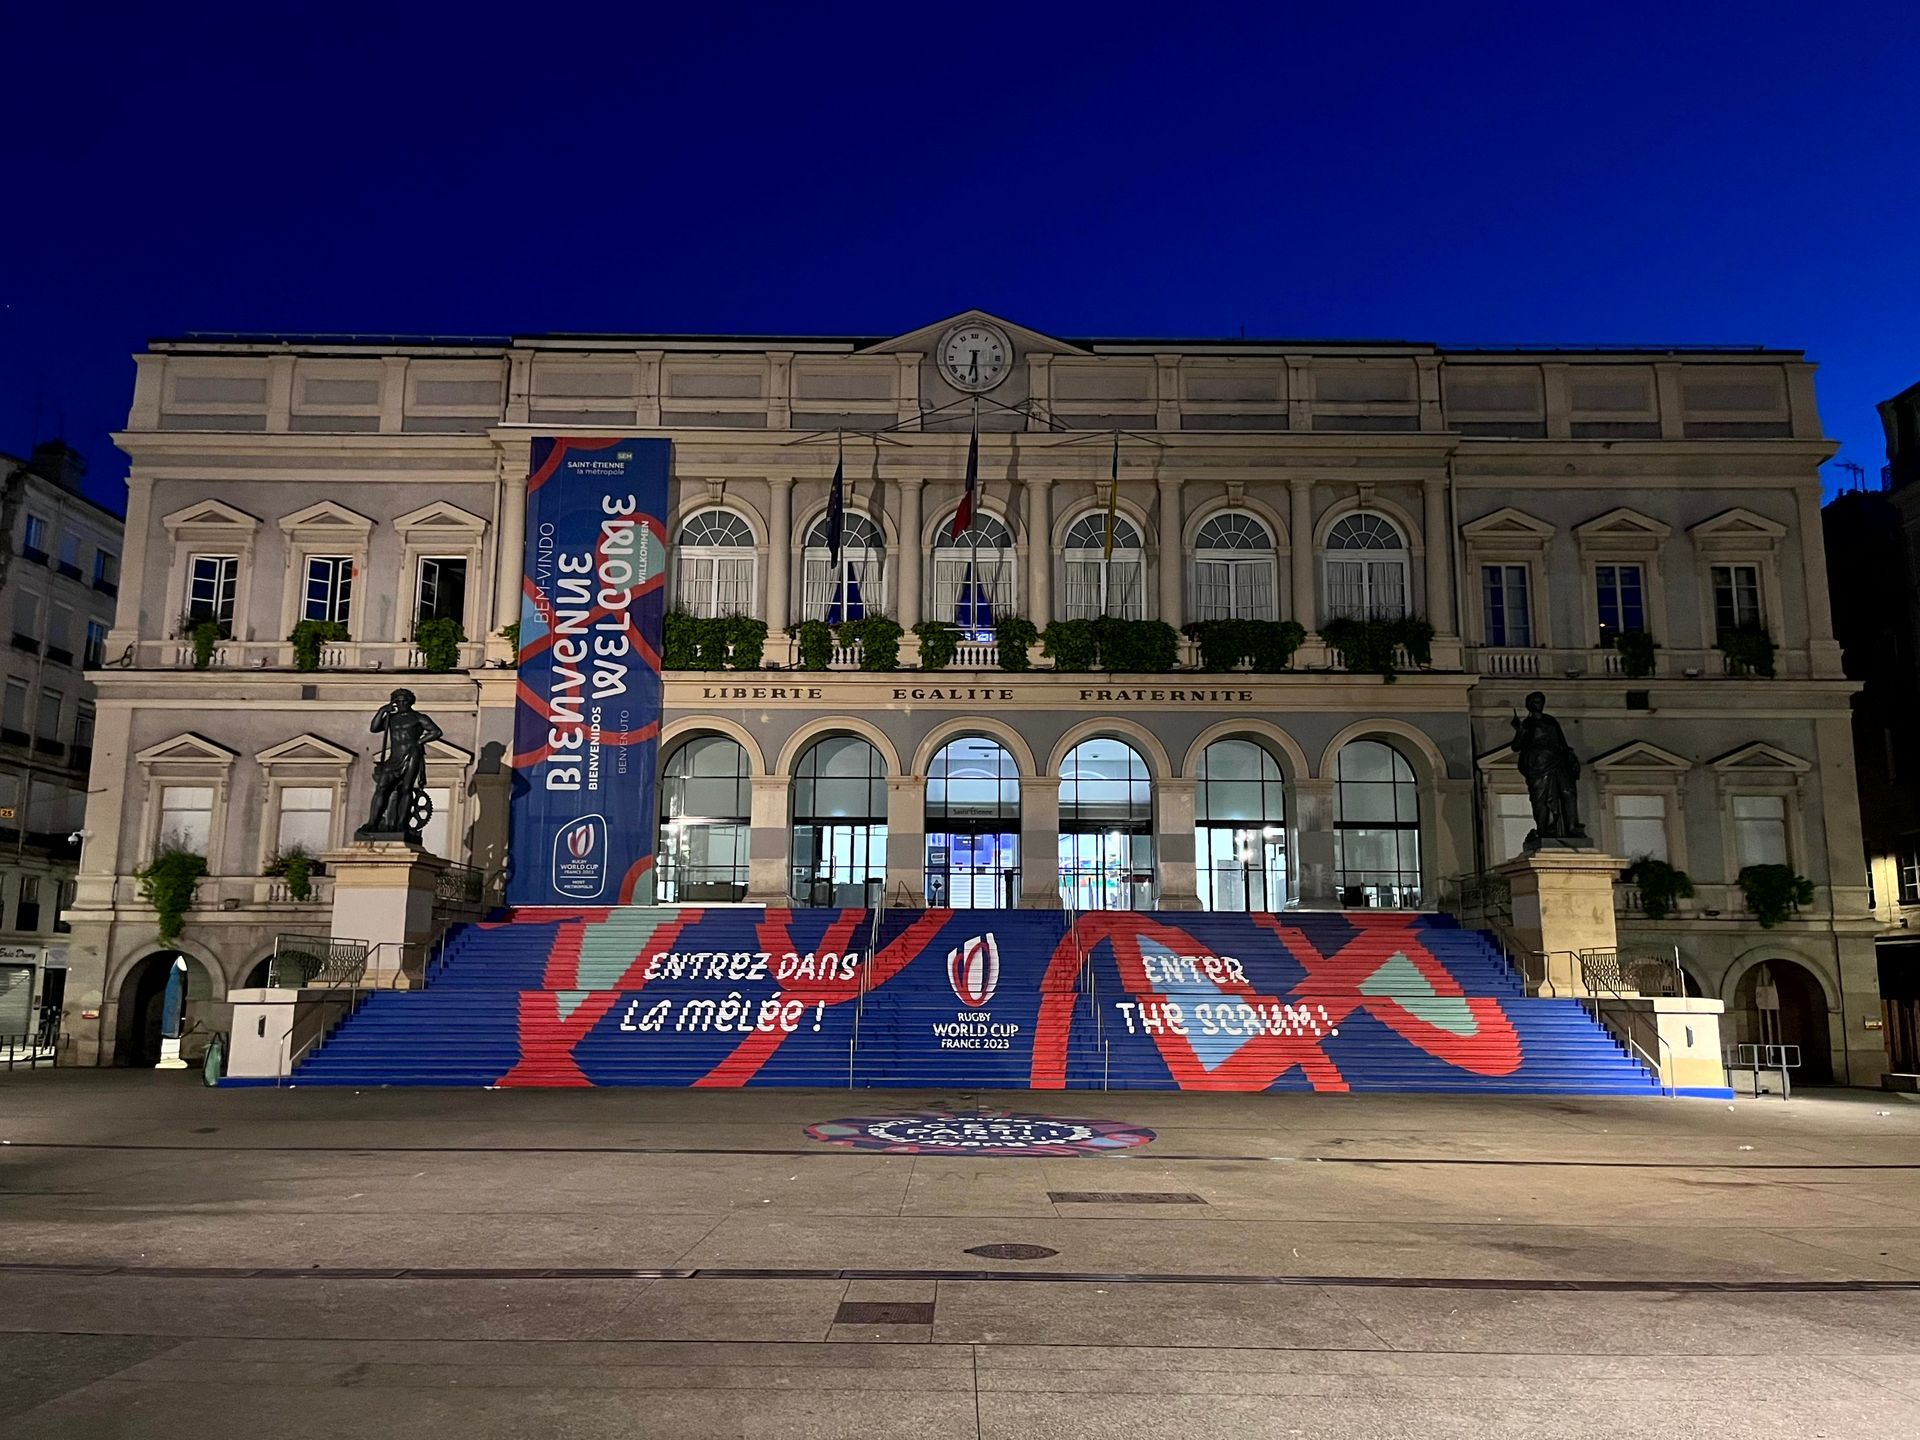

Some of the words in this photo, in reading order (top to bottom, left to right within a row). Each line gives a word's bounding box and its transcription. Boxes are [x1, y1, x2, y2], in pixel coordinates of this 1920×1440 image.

[638, 520, 649, 585] WILLKOMMEN
[533, 522, 555, 624] BEM-VINDO
[591, 494, 637, 700] WELCOME
[546, 552, 593, 791] BIENVENUE
[703, 688, 823, 699] LIBERTE
[893, 689, 1014, 700] EGALITE
[1079, 689, 1254, 702] FRATERNITE
[588, 706, 602, 790] BIENVENIDOS
[618, 710, 629, 774] BENVENUTO
[2, 809, 12, 817] 25
[642, 952, 772, 980] ENTREZ
[775, 953, 859, 980] DANS
[1142, 955, 1250, 984] ENTER
[620, 999, 672, 1031] LA
[675, 992, 804, 1032] MÊLÉE
[957, 1012, 991, 1022] RUGBY
[1115, 1002, 1190, 1035] THE
[932, 1022, 988, 1037] WORLD
[990, 1023, 1019, 1037] CUP
[941, 1039, 981, 1049] FRANCE
[983, 1039, 1010, 1049] 2023
